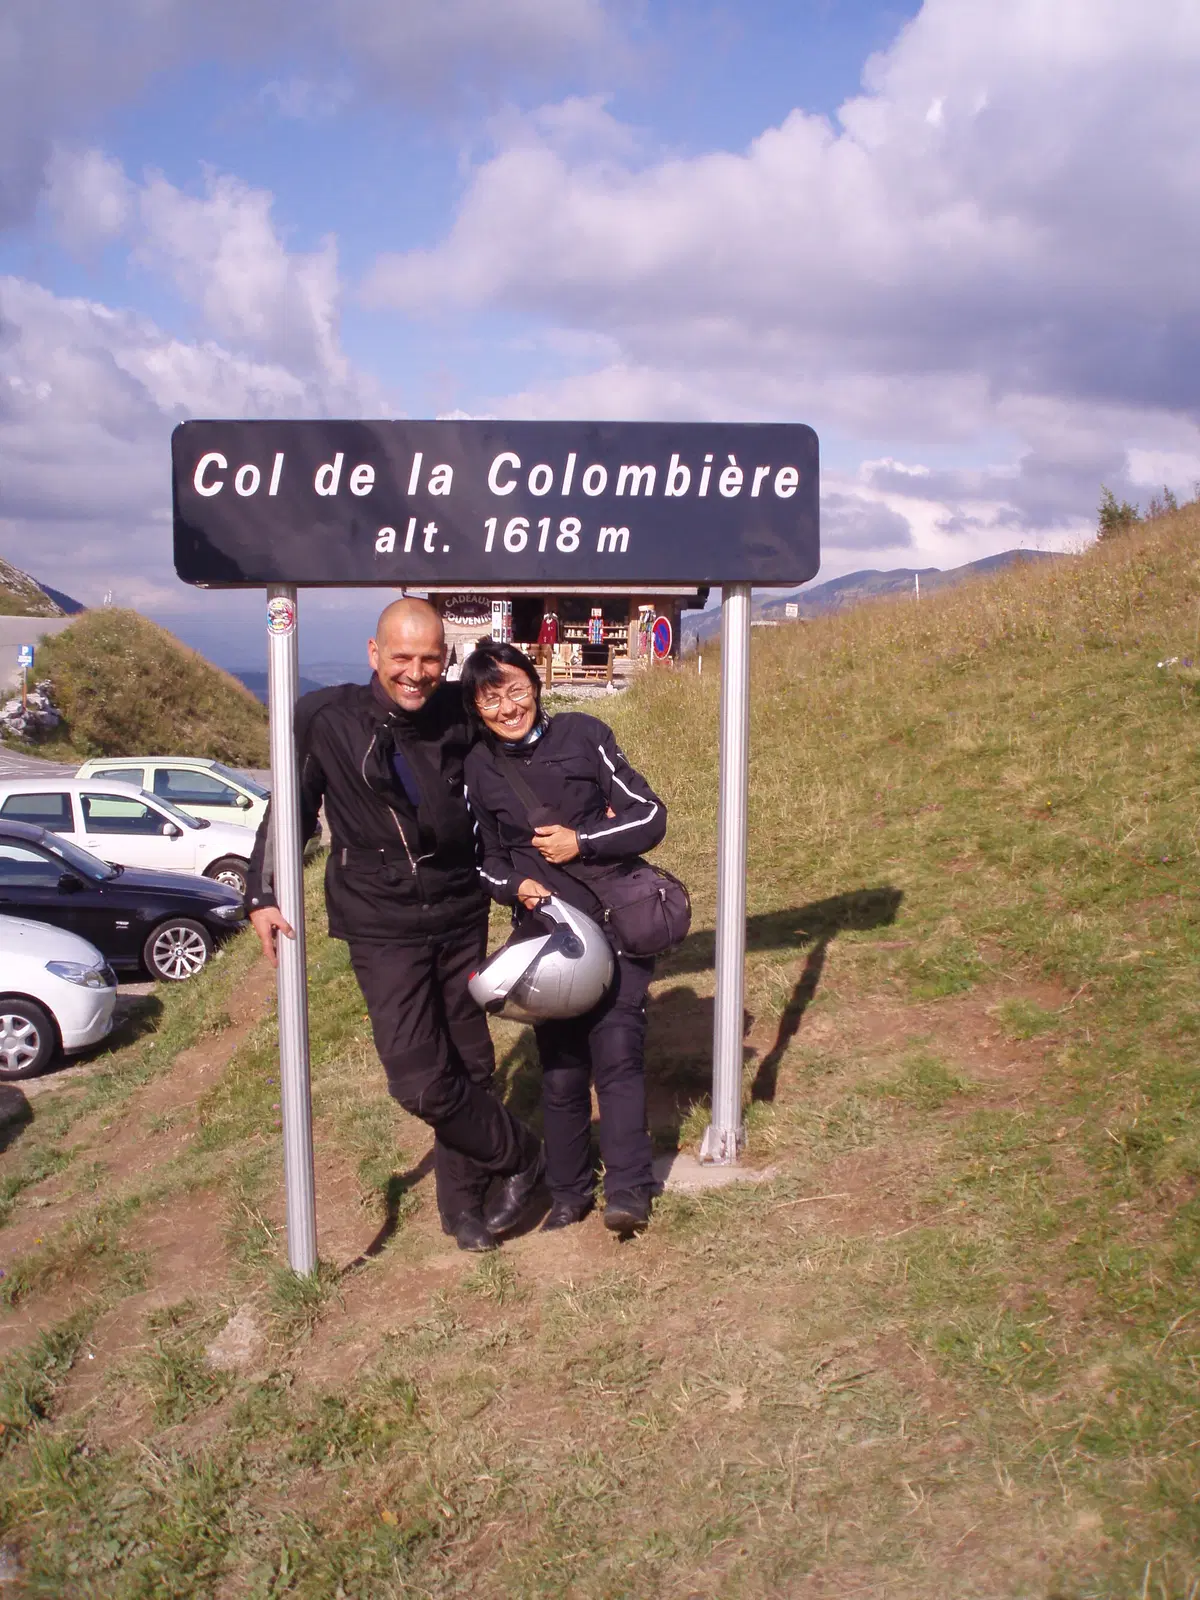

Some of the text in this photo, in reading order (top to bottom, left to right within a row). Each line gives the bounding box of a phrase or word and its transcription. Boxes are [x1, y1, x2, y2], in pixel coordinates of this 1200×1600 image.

[193, 451, 799, 499] Col de la Colombière
[374, 516, 630, 553] alt. 1618 m
[445, 594, 492, 608] CADEAUX
